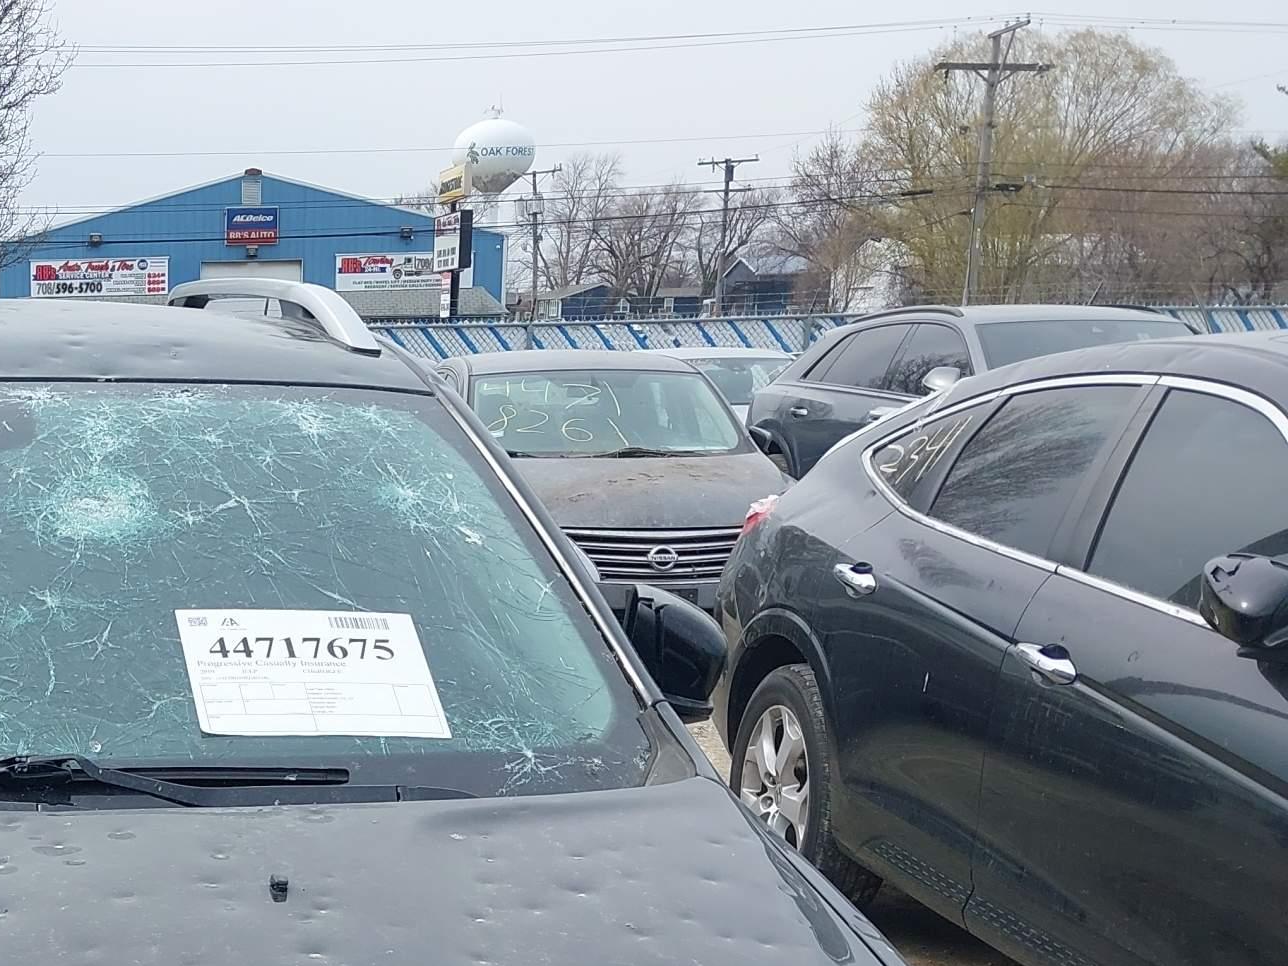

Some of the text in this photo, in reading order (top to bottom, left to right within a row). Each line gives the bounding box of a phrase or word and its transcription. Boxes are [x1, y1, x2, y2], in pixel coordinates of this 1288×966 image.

[480, 147, 503, 157] OAK
[232, 214, 274, 222] ACDelco
[250, 231, 275, 239] AUTO
[36, 282, 103, 295] 708/596-5700
[209, 636, 395, 661] 44717675
[197, 659, 347, 668] Progressive Casualty Insurance
